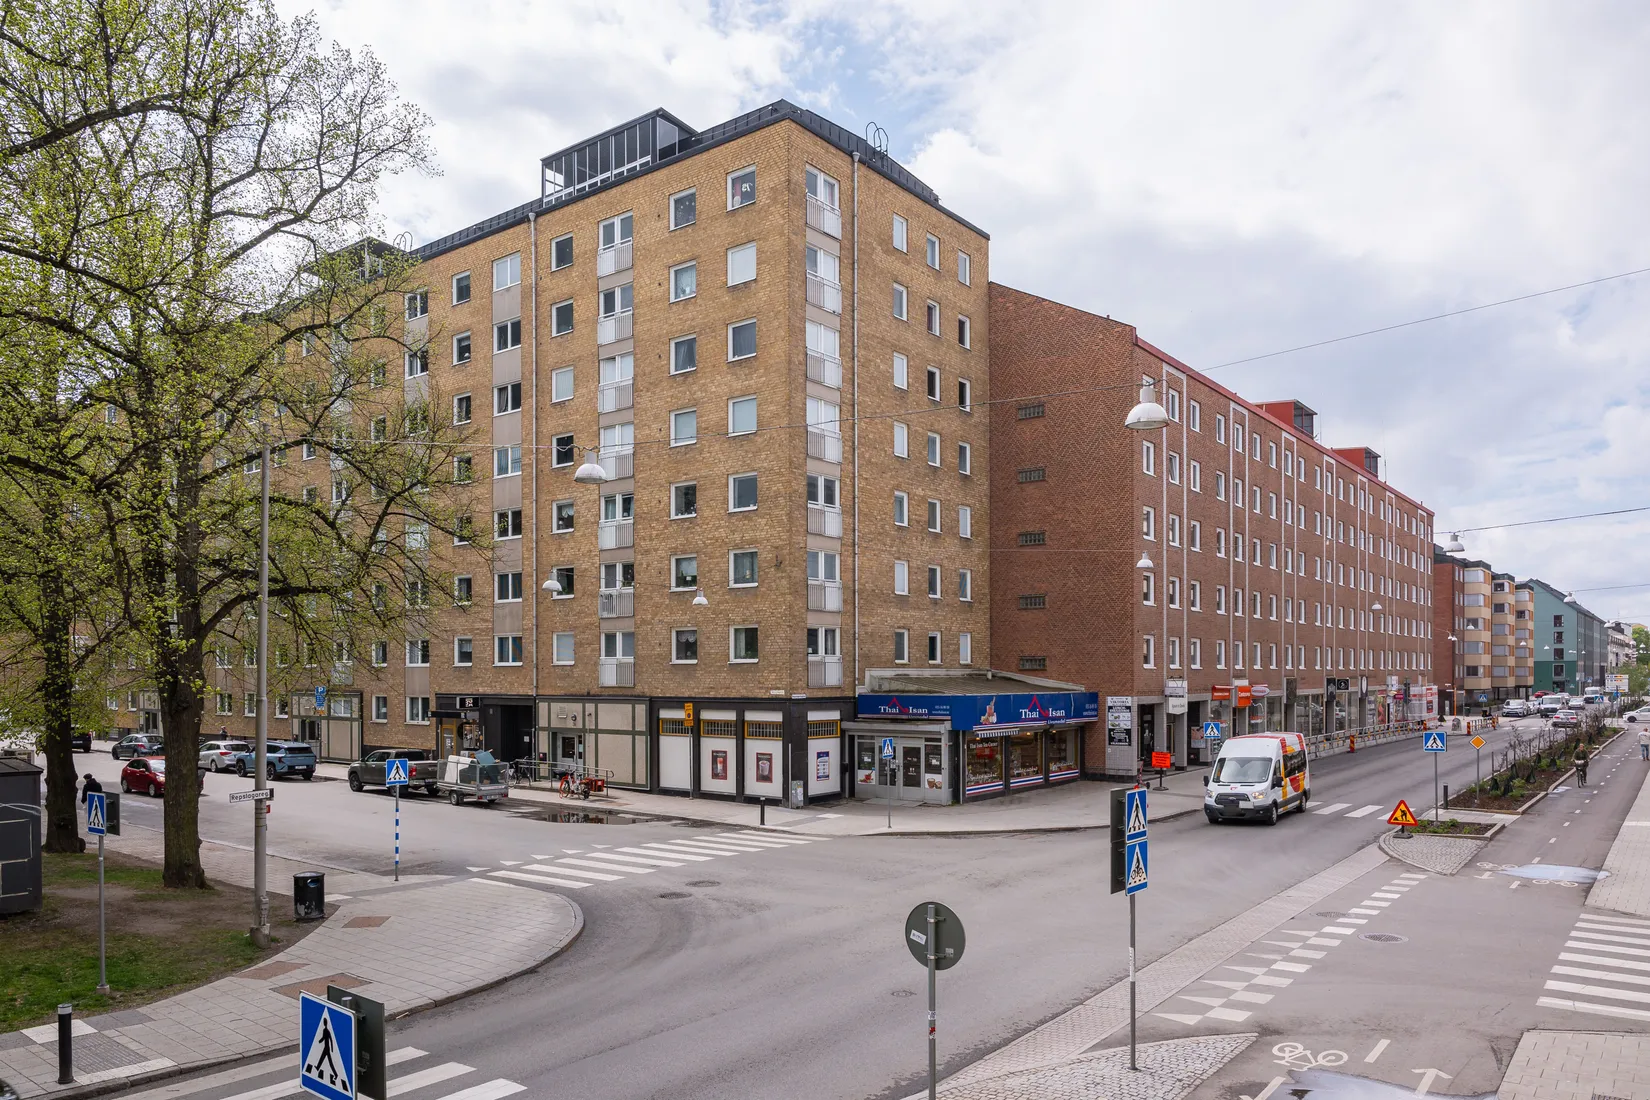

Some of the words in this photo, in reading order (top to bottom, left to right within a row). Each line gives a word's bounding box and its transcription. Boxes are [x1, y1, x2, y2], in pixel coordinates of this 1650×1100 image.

[878, 705, 899, 713] Thai
[908, 706, 928, 714] Isan
[1019, 708, 1039, 718] Thai
[1048, 707, 1066, 717] Isan
